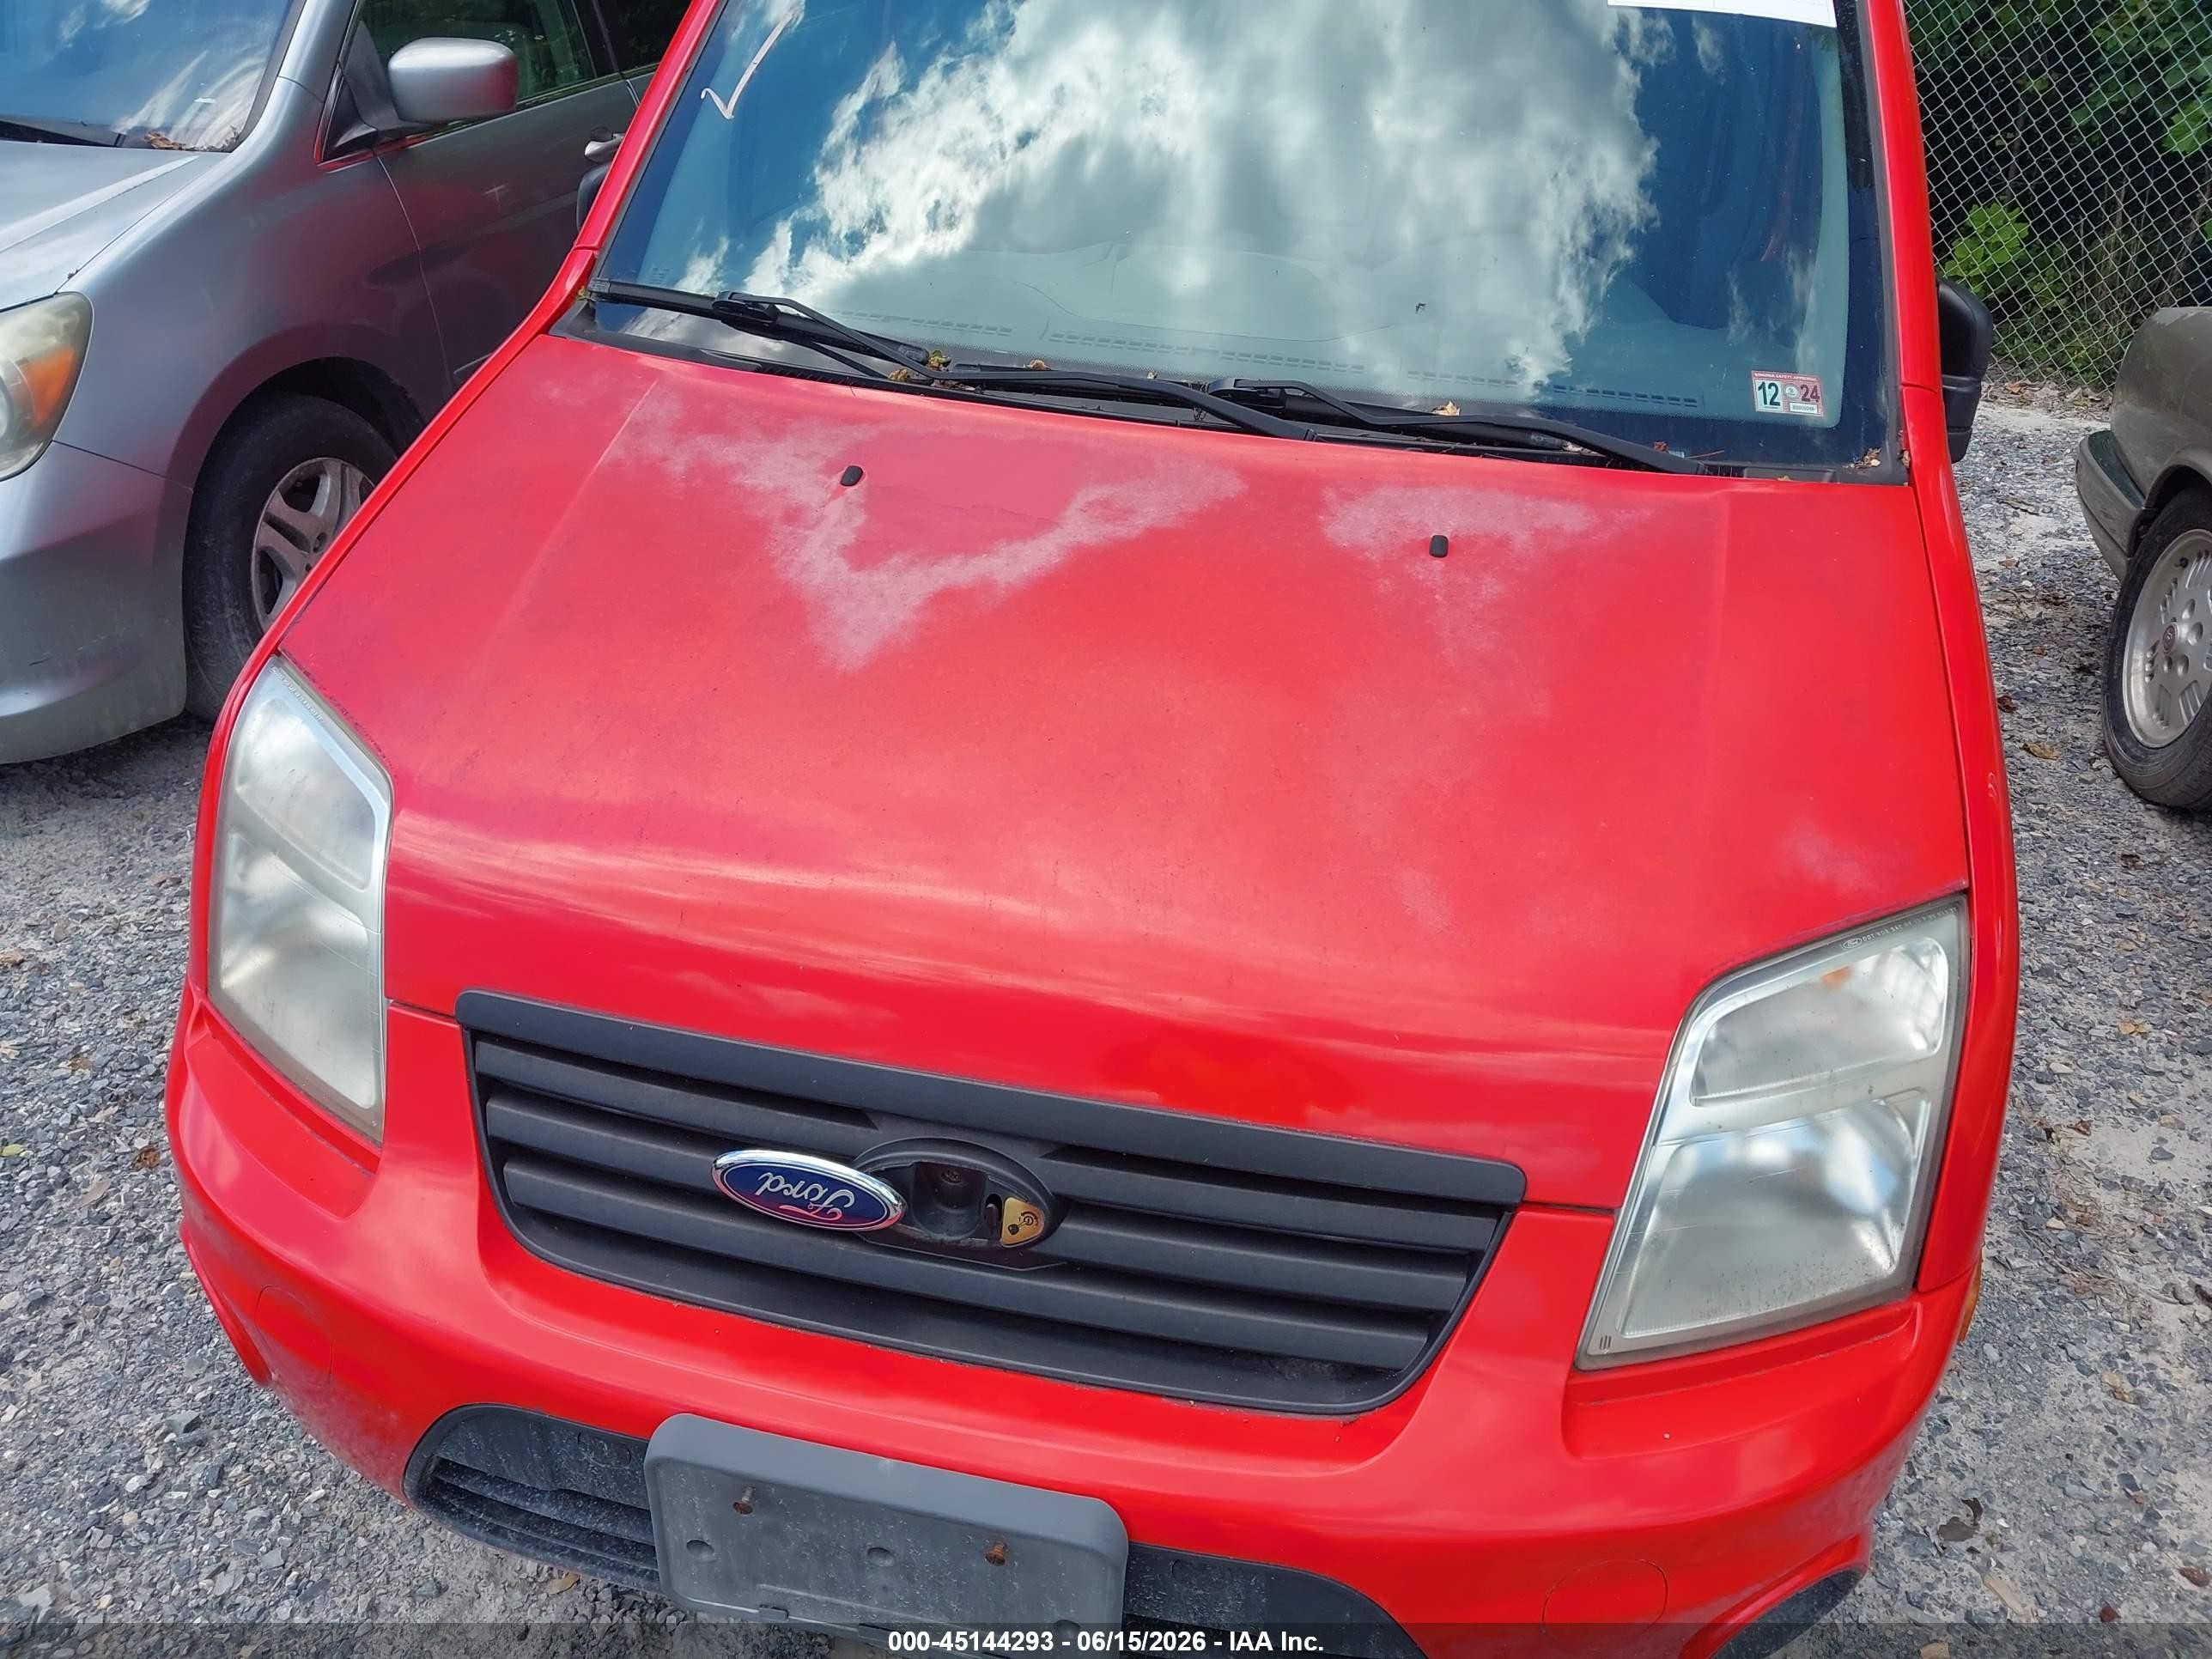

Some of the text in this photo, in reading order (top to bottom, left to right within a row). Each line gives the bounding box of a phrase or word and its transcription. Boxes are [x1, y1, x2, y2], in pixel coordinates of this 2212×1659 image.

[1758, 381, 1820, 406] 12 24
[757, 1172, 855, 1221] Ford
